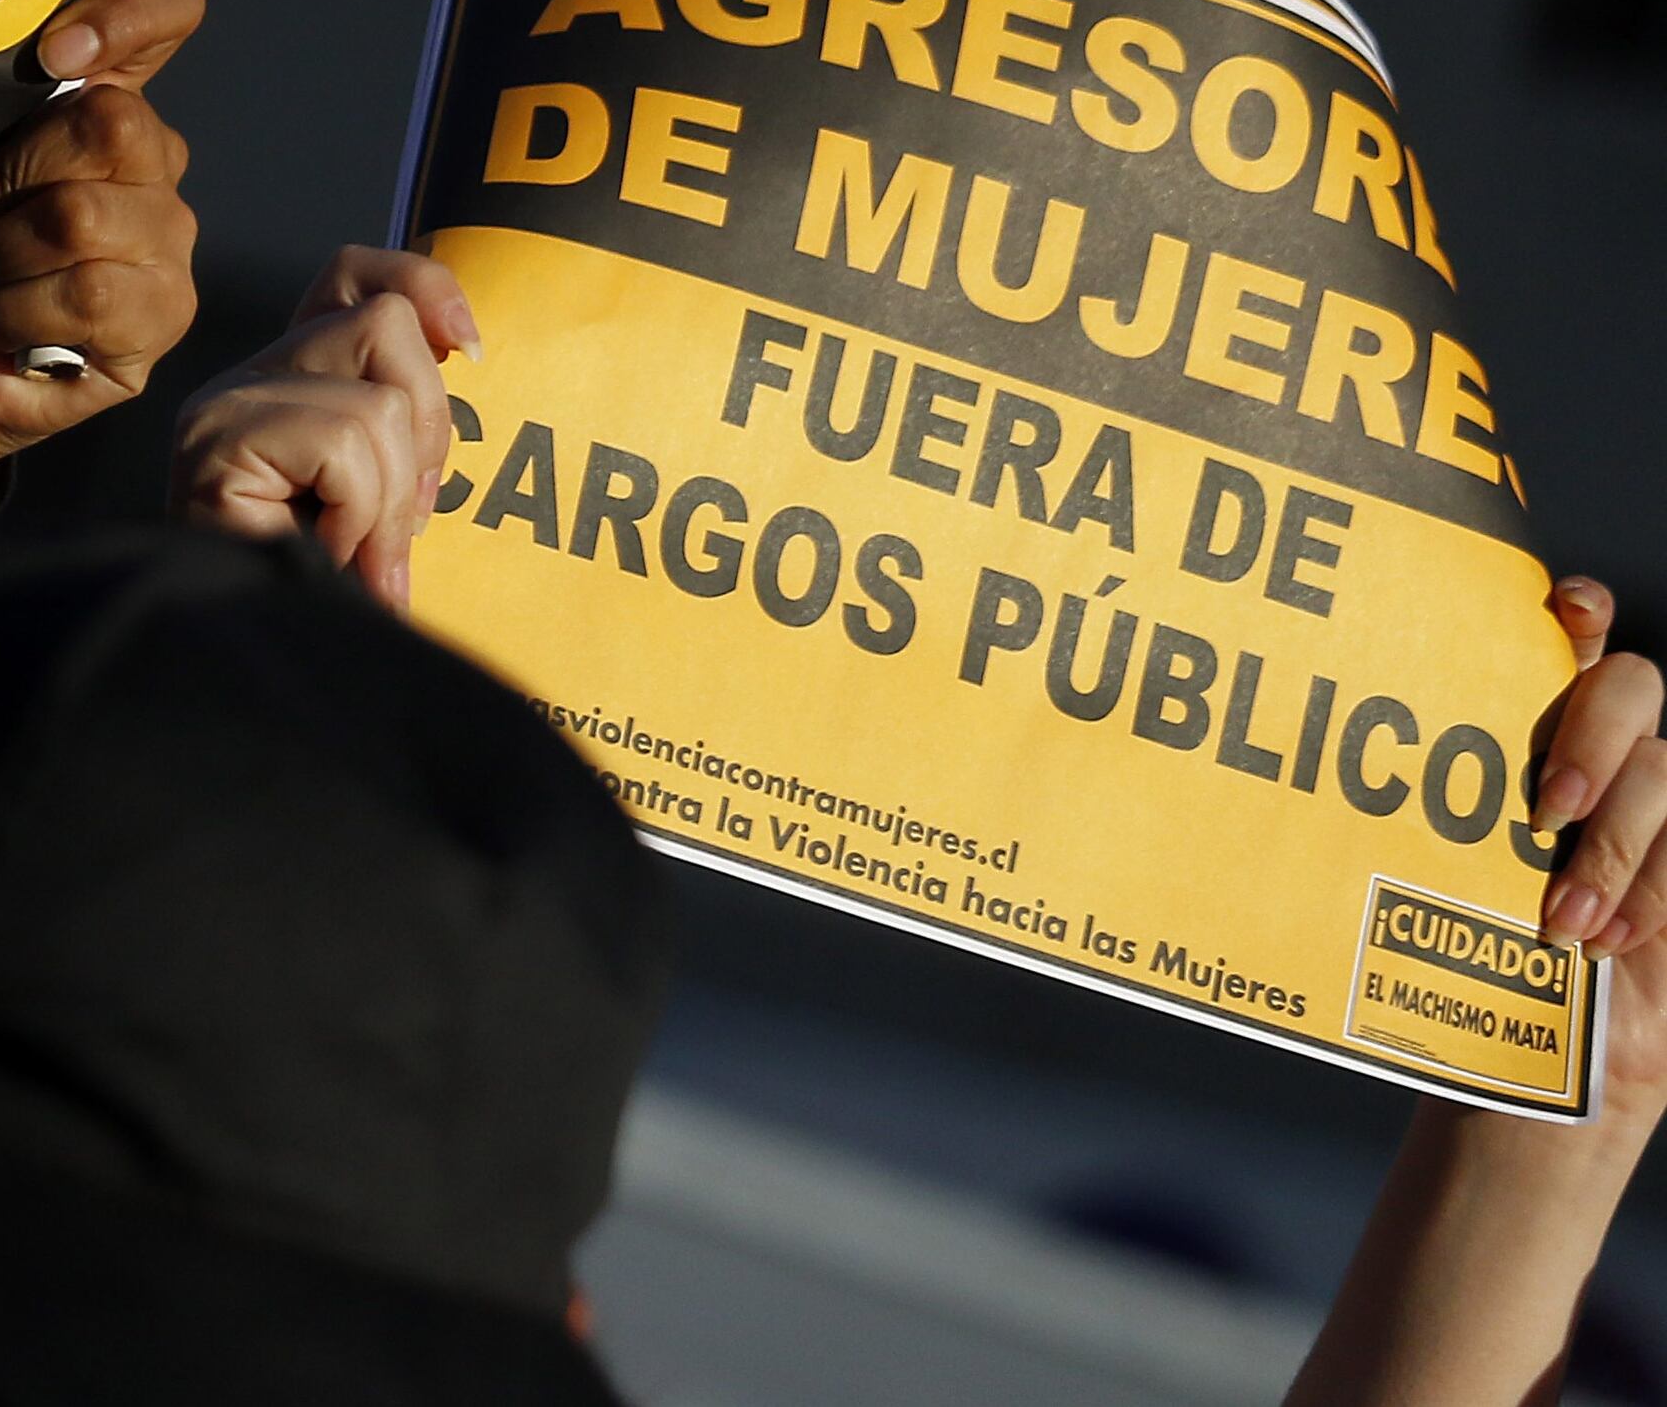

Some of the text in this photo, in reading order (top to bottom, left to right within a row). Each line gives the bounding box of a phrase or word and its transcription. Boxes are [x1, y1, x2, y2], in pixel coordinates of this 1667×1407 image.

[482, 82, 1527, 510] DE MUJERE
[718, 310, 1356, 618] FUERA DE
[529, 698, 1019, 873] asviolenciacontramujeres.cl
[599, 771, 1306, 1018] ontra la Violencia hacia las Mujeres
[1373, 903, 1565, 992] ¡CUIDADO!
[1364, 972, 1558, 1055] EL MACHISMO MATA
